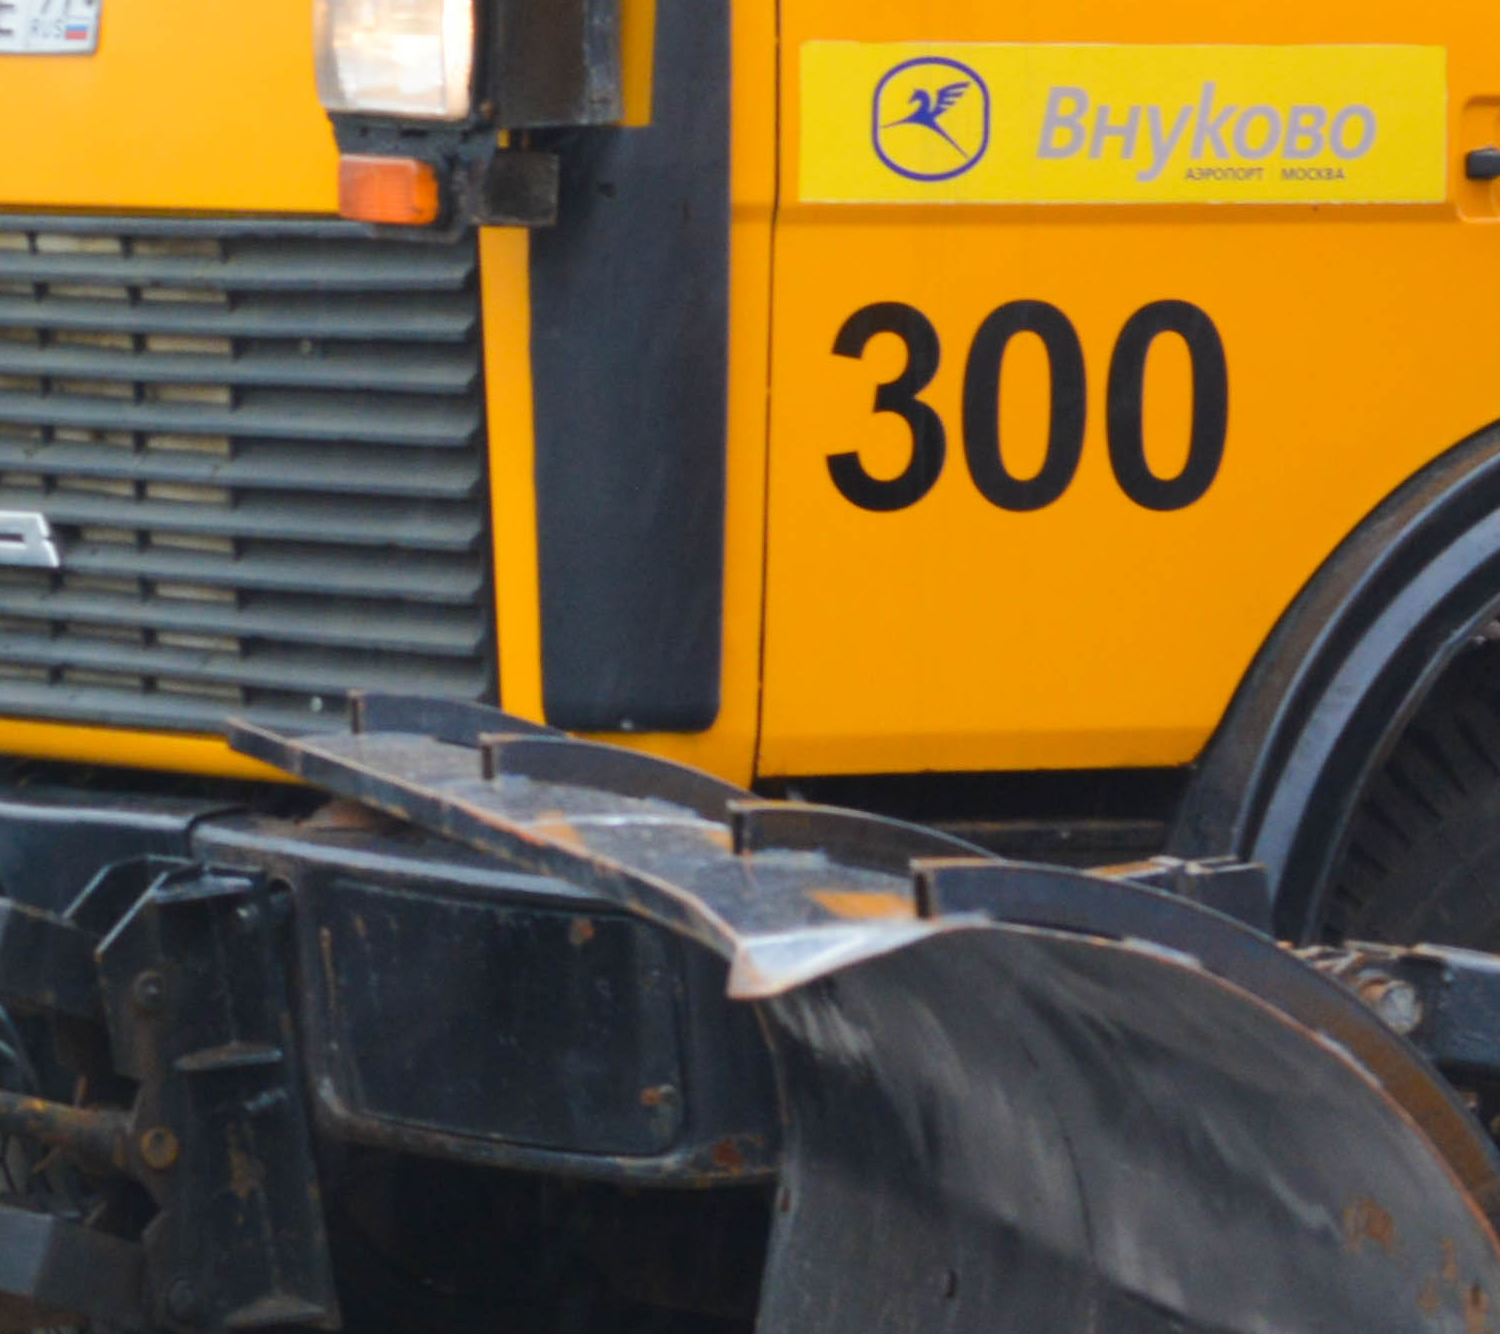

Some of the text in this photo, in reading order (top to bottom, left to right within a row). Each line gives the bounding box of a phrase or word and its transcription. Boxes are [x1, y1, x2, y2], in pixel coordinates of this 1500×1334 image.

[1036, 80, 1378, 182] Внуково
[1184, 167, 1345, 180] АЭРОПОРТ МОСКВА
[825, 298, 1230, 512] 300
